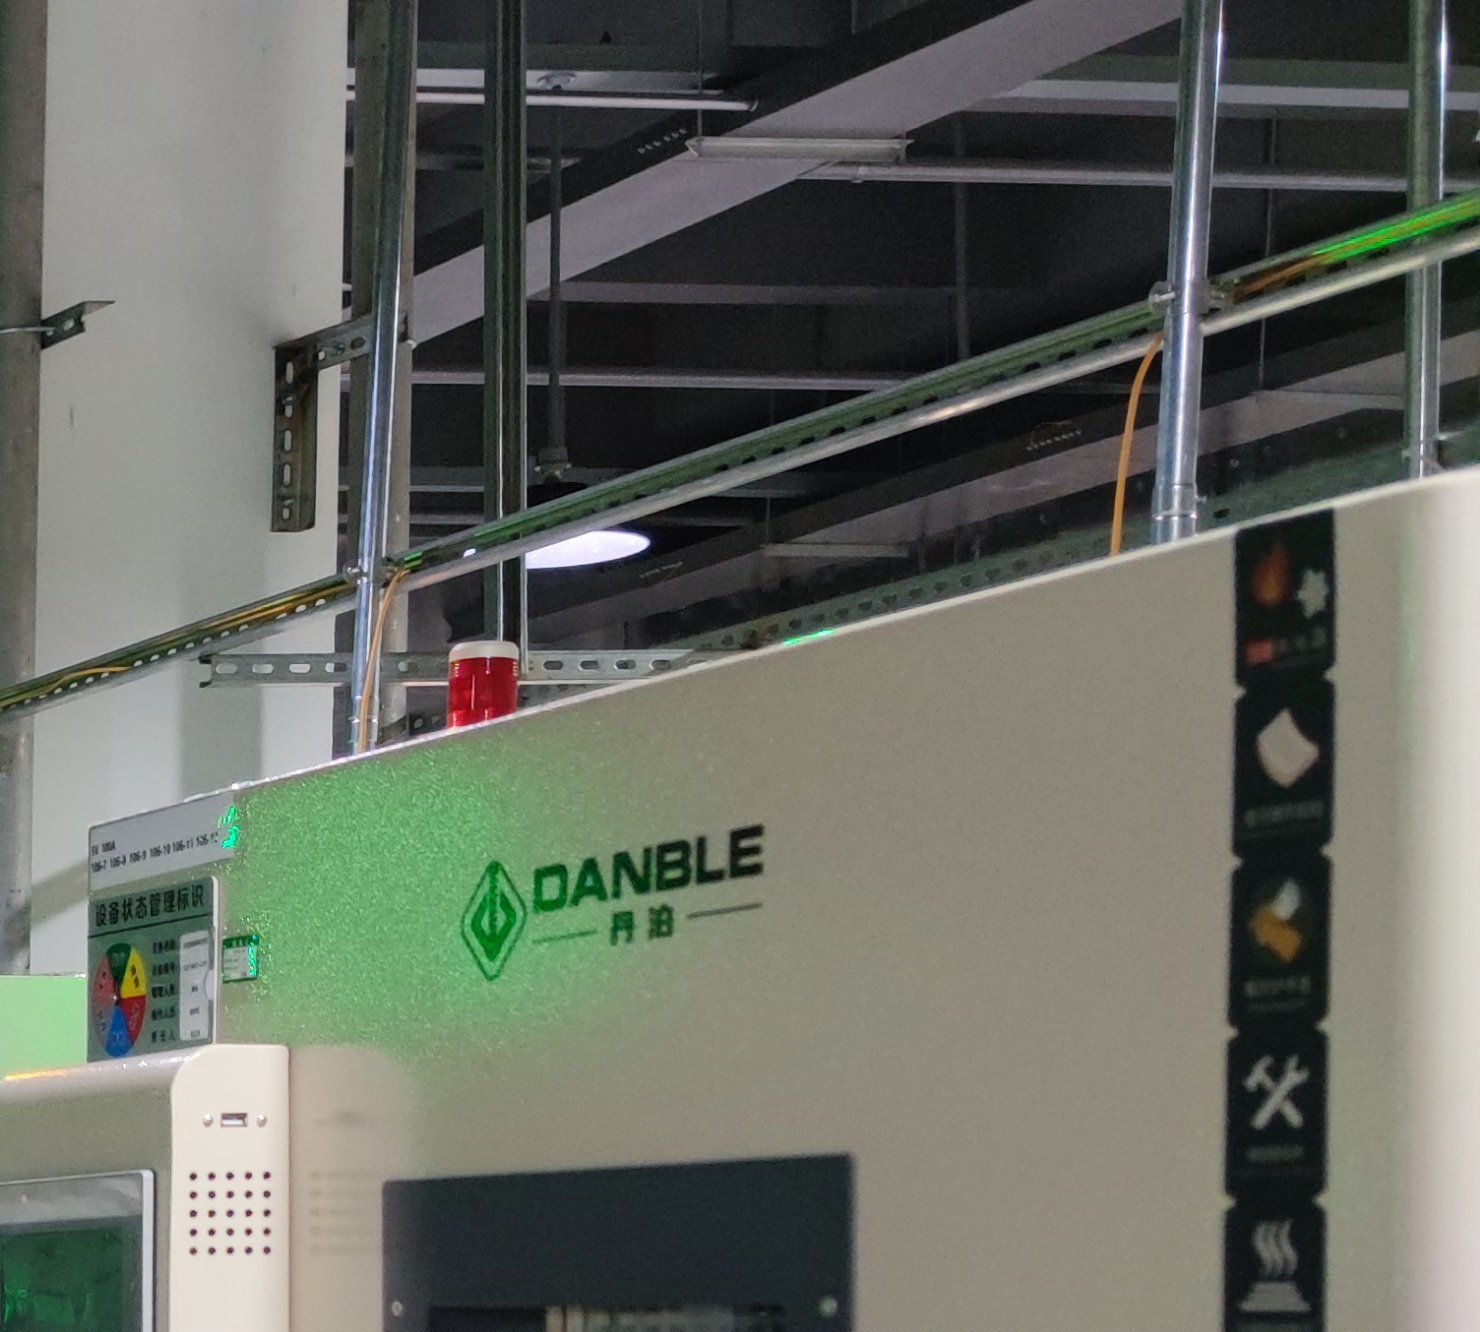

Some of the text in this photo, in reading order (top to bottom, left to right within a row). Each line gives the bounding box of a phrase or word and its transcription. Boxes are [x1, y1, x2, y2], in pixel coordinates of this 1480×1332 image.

[532, 823, 765, 915] DANBLE
[95, 883, 205, 928] 设备状态管理标识
[610, 903, 675, 947] 丹泊
